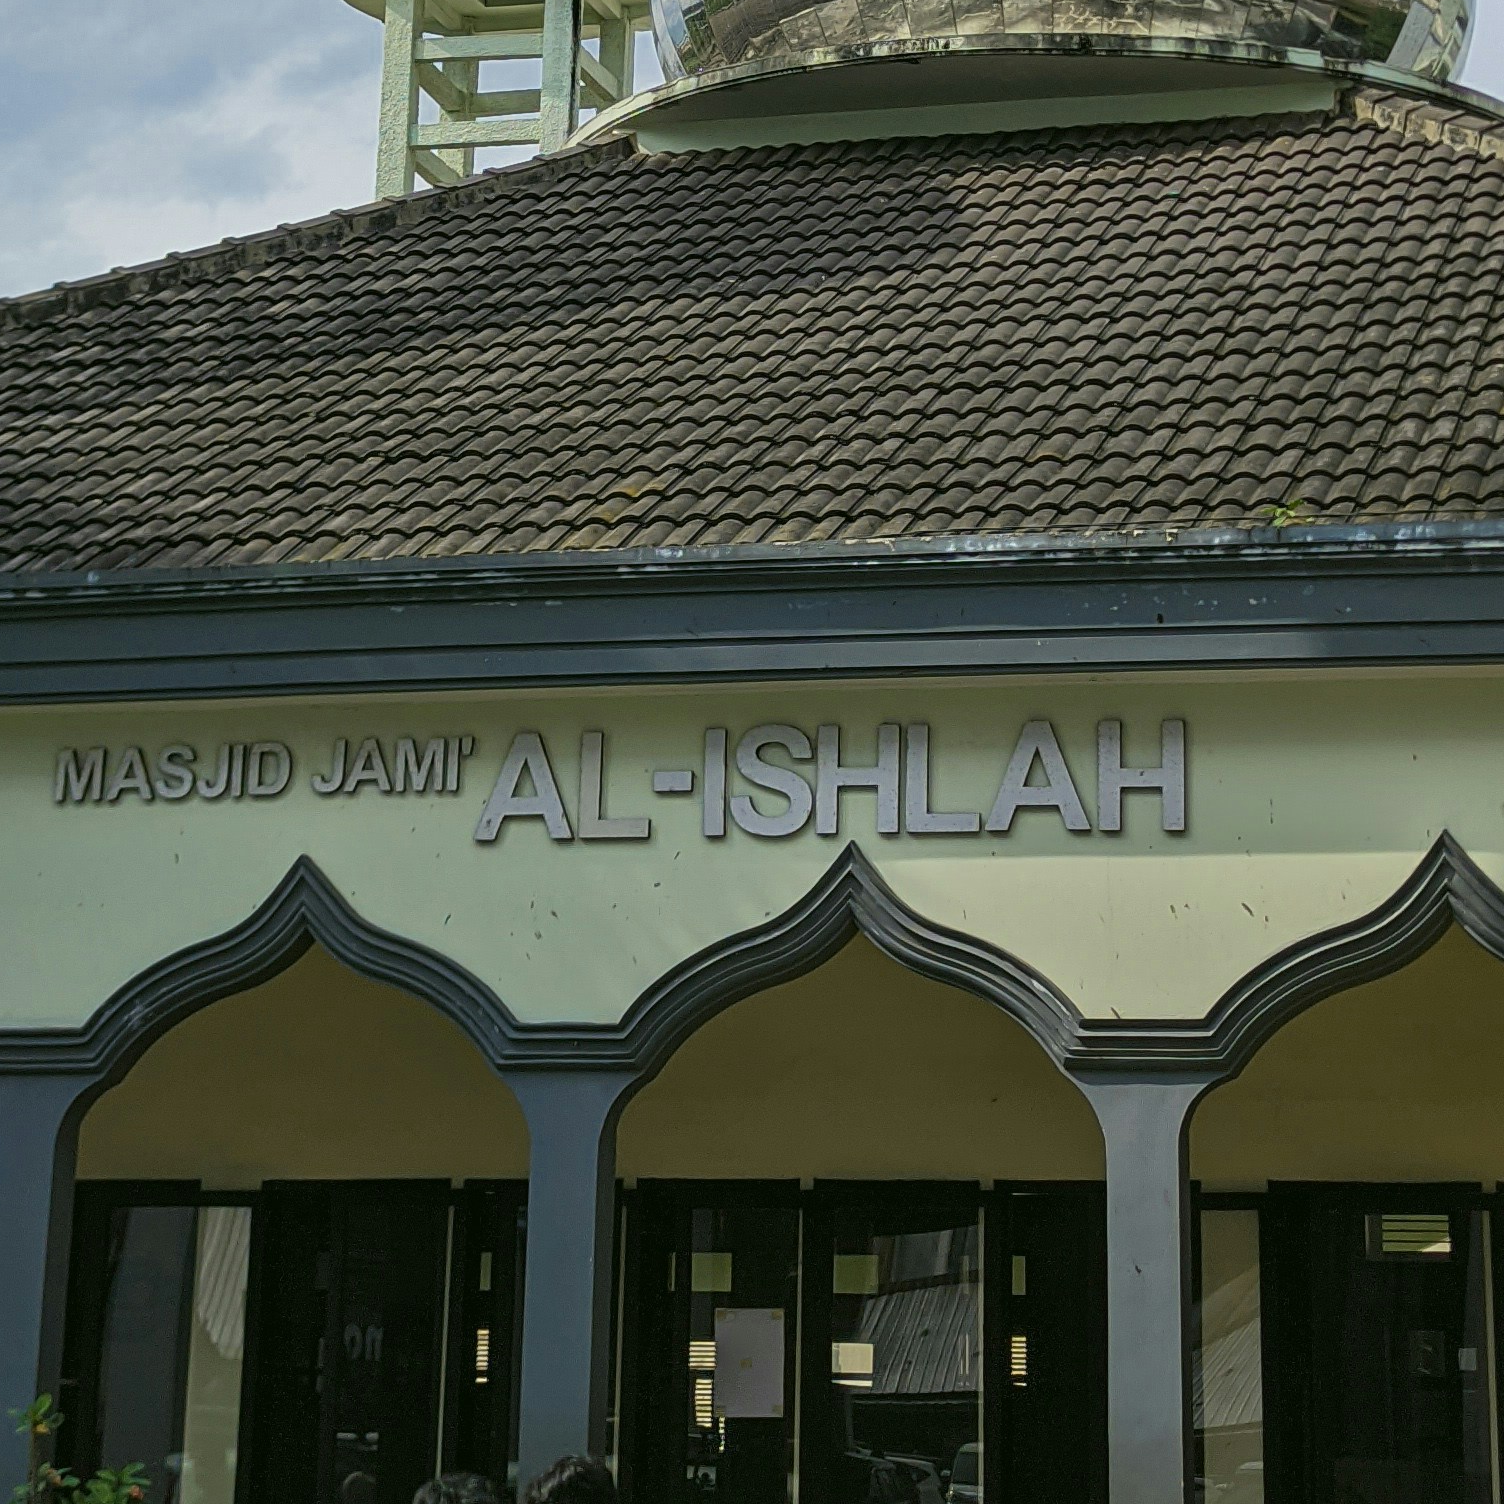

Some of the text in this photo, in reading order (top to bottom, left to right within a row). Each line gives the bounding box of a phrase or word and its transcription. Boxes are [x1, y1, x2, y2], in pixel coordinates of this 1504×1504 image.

[54, 719, 1185, 842] MASJID JAMI' AL-ISHLAH
